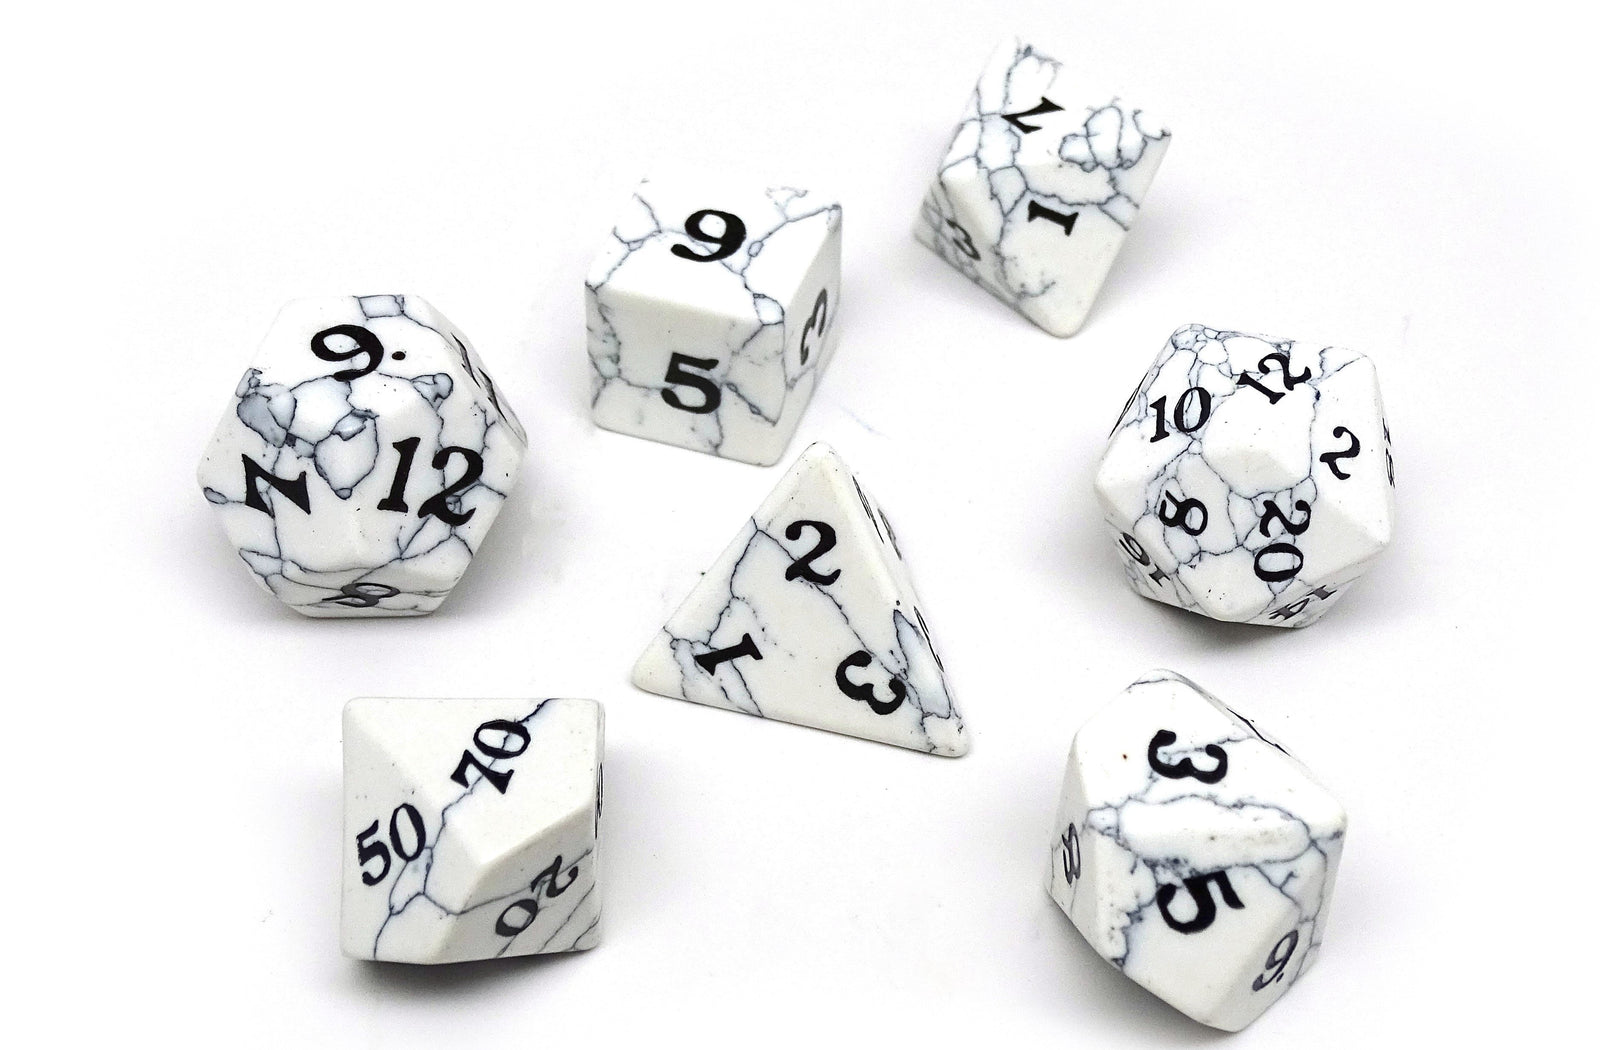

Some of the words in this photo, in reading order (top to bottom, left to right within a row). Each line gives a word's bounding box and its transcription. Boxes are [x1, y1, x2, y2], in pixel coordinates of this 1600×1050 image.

[1000, 96, 1066, 134] 7
[1028, 200, 1079, 237] 1
[800, 288, 828, 366] 3
[660, 352, 721, 415] 5
[1236, 352, 1312, 405] 12
[1149, 386, 1212, 443] 10
[241, 453, 311, 519] 7
[377, 436, 484, 527] 12
[1319, 426, 1361, 481] 2
[1158, 489, 1209, 536] 8
[1253, 499, 1312, 583] 20
[785, 520, 842, 586] 2
[693, 632, 764, 676] 1
[835, 650, 907, 716] 3
[450, 718, 532, 794] 70
[1147, 729, 1229, 784] 3
[355, 803, 427, 887] 50
[495, 855, 579, 938] 20
[1155, 870, 1246, 936] 5
